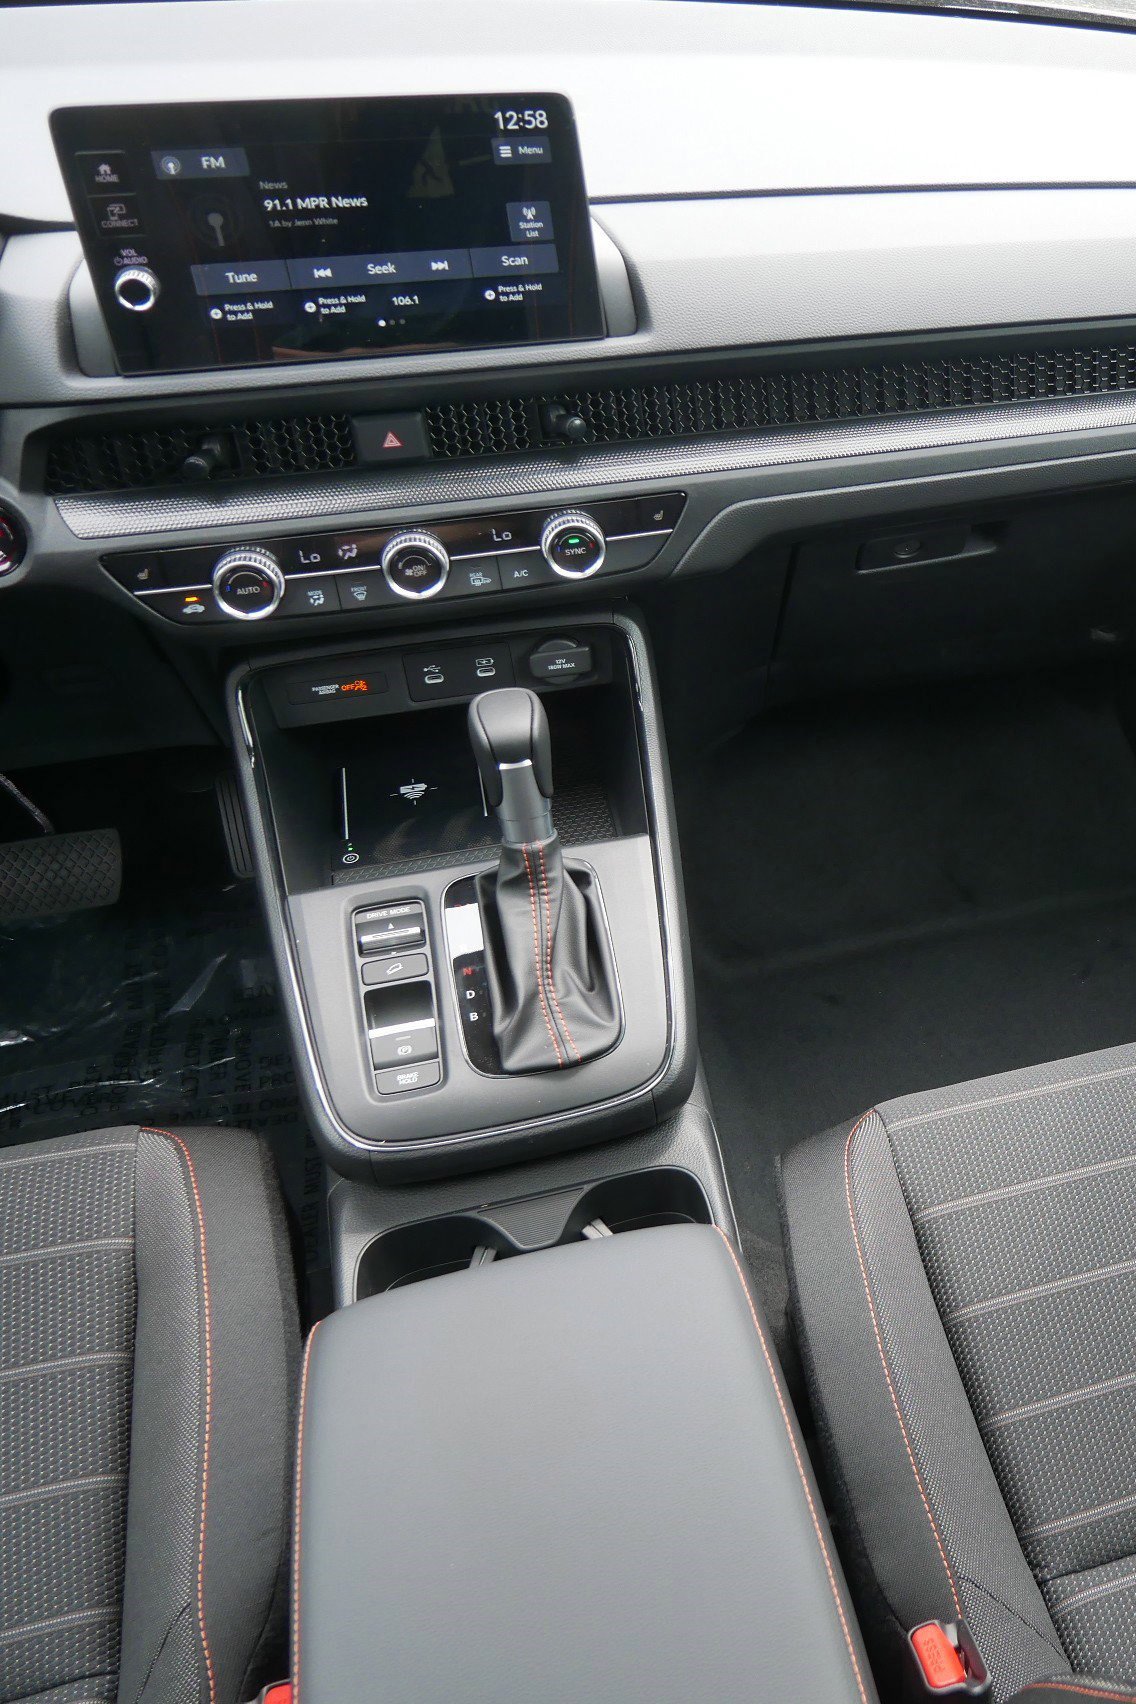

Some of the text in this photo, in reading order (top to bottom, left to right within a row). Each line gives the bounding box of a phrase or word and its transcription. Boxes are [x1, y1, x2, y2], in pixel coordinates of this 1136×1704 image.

[494, 110, 548, 130] 12:58
[518, 146, 543, 155] Menu
[202, 157, 225, 169] FM
[259, 181, 288, 190] News
[264, 196, 368, 211] 91.1 MPR News
[102, 219, 138, 228] CONNECT
[281, 219, 292, 228] by
[519, 221, 544, 229] Station
[526, 230, 539, 238] List
[123, 256, 148, 264] AUDIO
[501, 255, 528, 267] Scan
[367, 262, 396, 274] Seek
[225, 272, 258, 284] Tune
[498, 285, 516, 293] Press
[525, 283, 542, 291] Hold
[319, 297, 339, 305] Press
[347, 295, 365, 303] Hold
[392, 296, 419, 306] 106.1
[508, 293, 523, 301] Add
[224, 303, 245, 311] Press
[254, 301, 273, 309] Hold
[330, 305, 345, 313] Add
[236, 311, 253, 320] Add
[565, 547, 587, 556] SYNC
[514, 569, 529, 578] A/C
[236, 586, 260, 595] AUTO
[367, 906, 411, 919] DRIVE MODE
[466, 991, 475, 999] D
[469, 1013, 479, 1021] B
